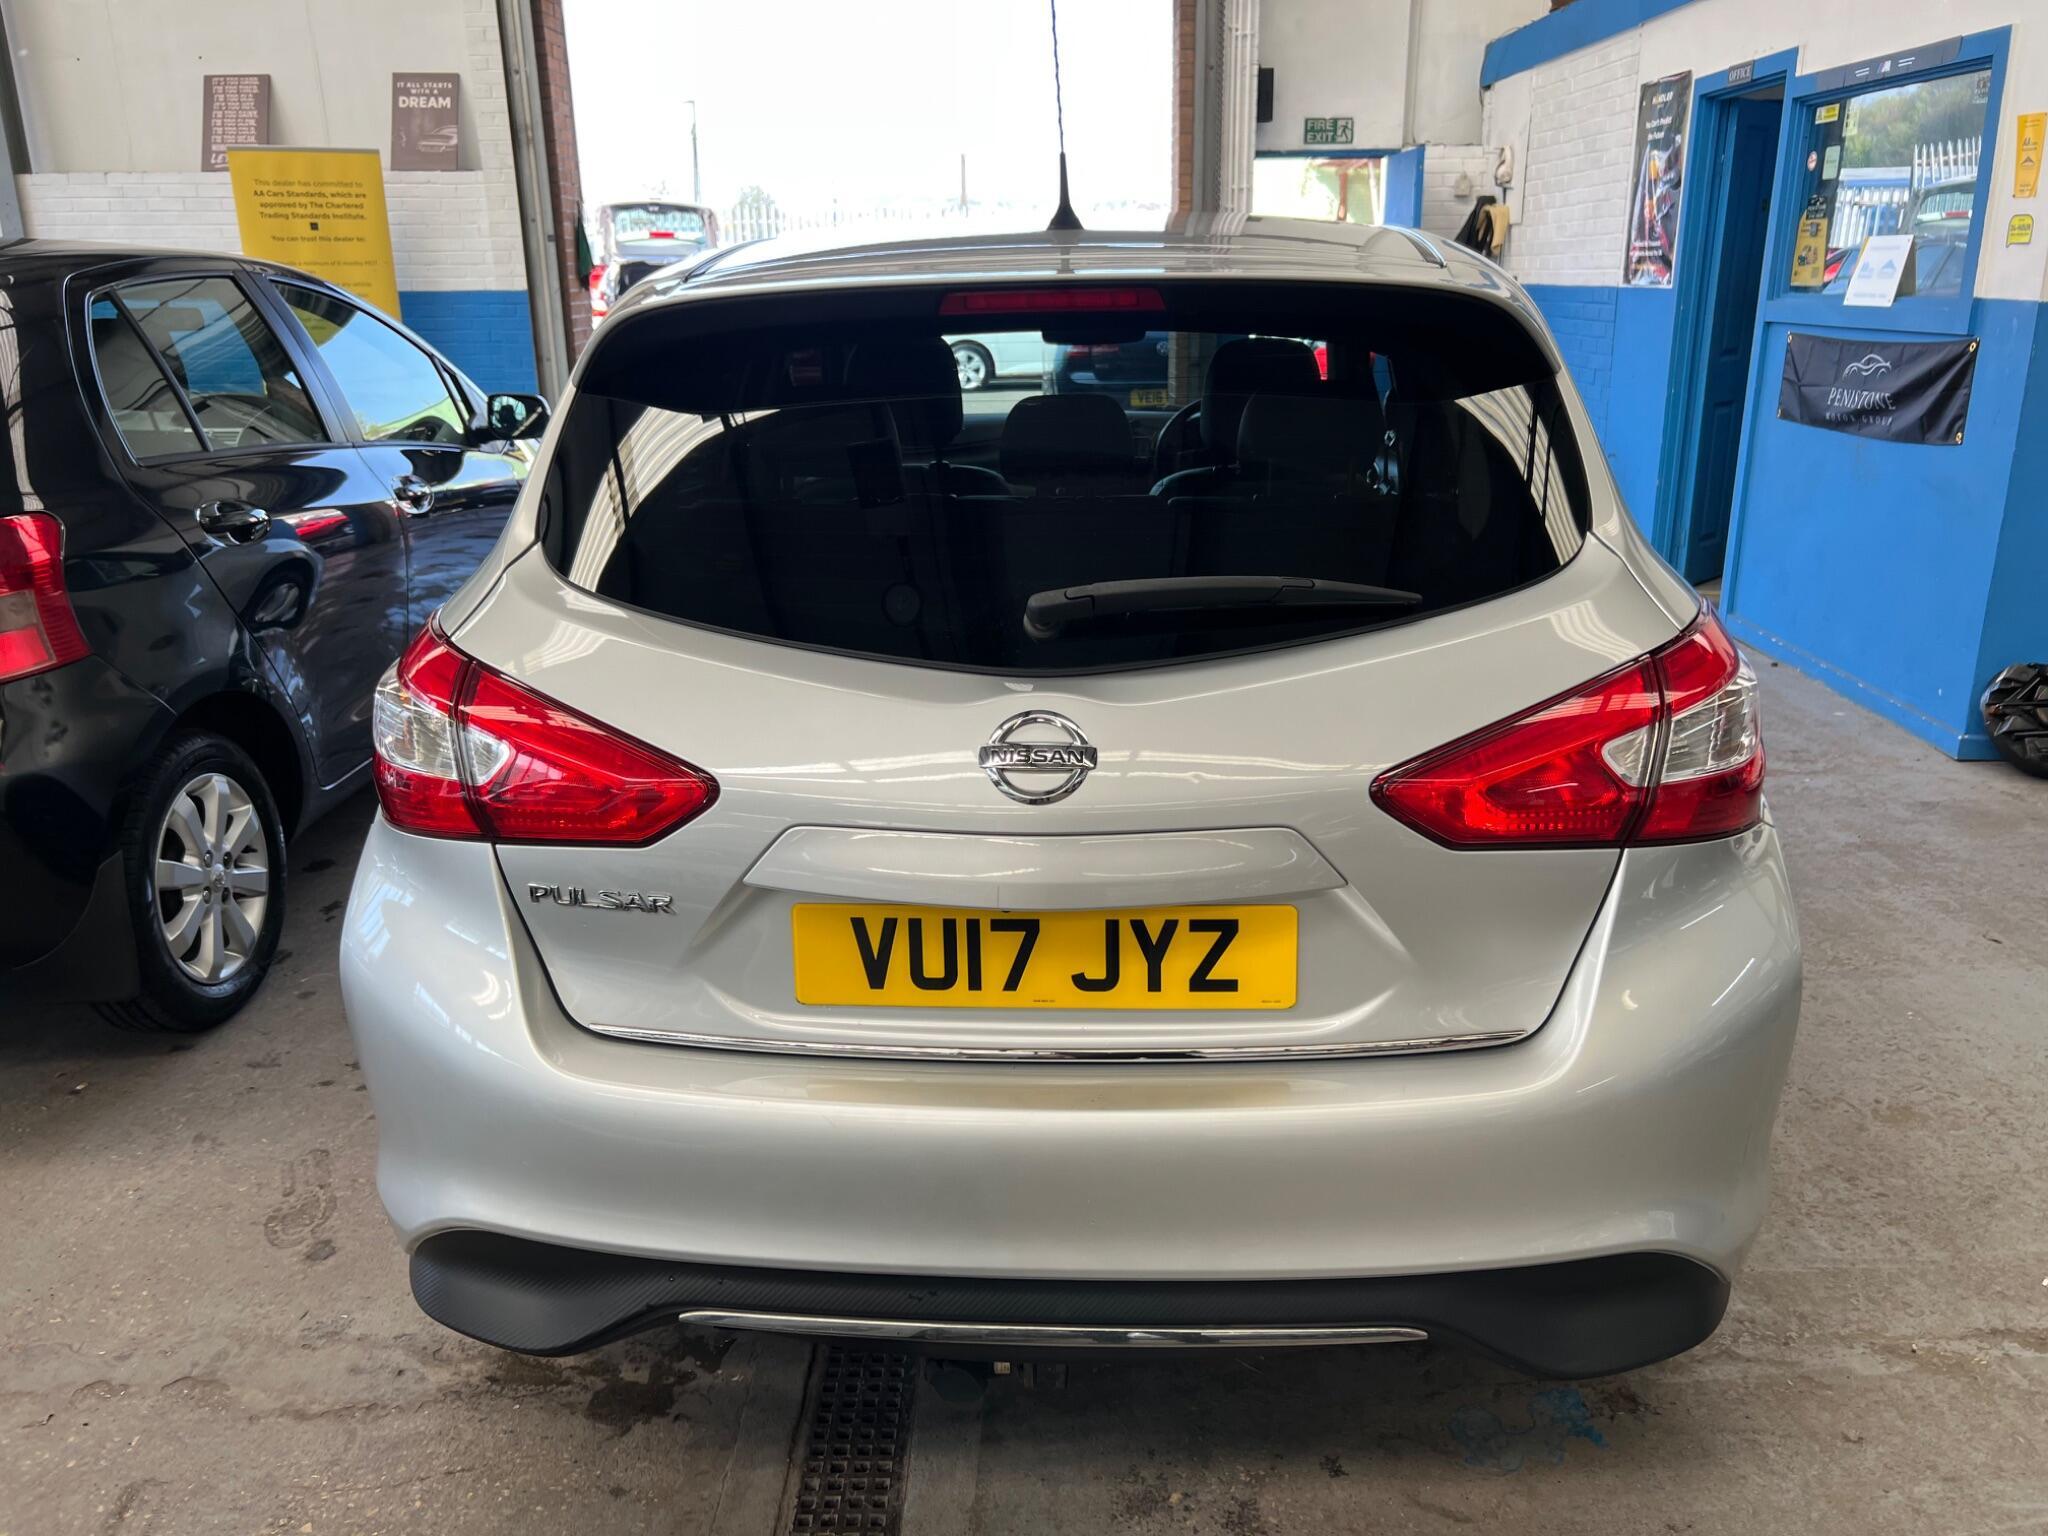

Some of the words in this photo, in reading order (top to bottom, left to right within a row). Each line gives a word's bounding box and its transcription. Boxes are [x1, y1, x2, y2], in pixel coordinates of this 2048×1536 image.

[1729, 65, 1751, 81] OFFICE
[226, 77, 239, 85] TOO
[227, 102, 240, 110] TOO
[398, 95, 452, 109] DREAM
[224, 110, 237, 118] TOO
[224, 119, 236, 127] TOO
[1307, 120, 1335, 130] FIRE
[224, 127, 237, 135] TOO
[223, 135, 236, 143] TOO
[1307, 132, 1334, 142] EXIT
[254, 179, 270, 187] This
[313, 180, 353, 188] committed
[286, 190, 329, 199] Standards,
[298, 202, 308, 210] by
[260, 212, 290, 220] Trading
[1827, 387, 1896, 410] PENISTONE
[1826, 411, 1855, 422] MOTOR
[1862, 415, 1893, 426] GROUP
[990, 748, 1085, 764] NISSAN
[527, 881, 677, 916] PULSAR
[850, 917, 1041, 992] VU17
[1071, 919, 1239, 993] JYZ
